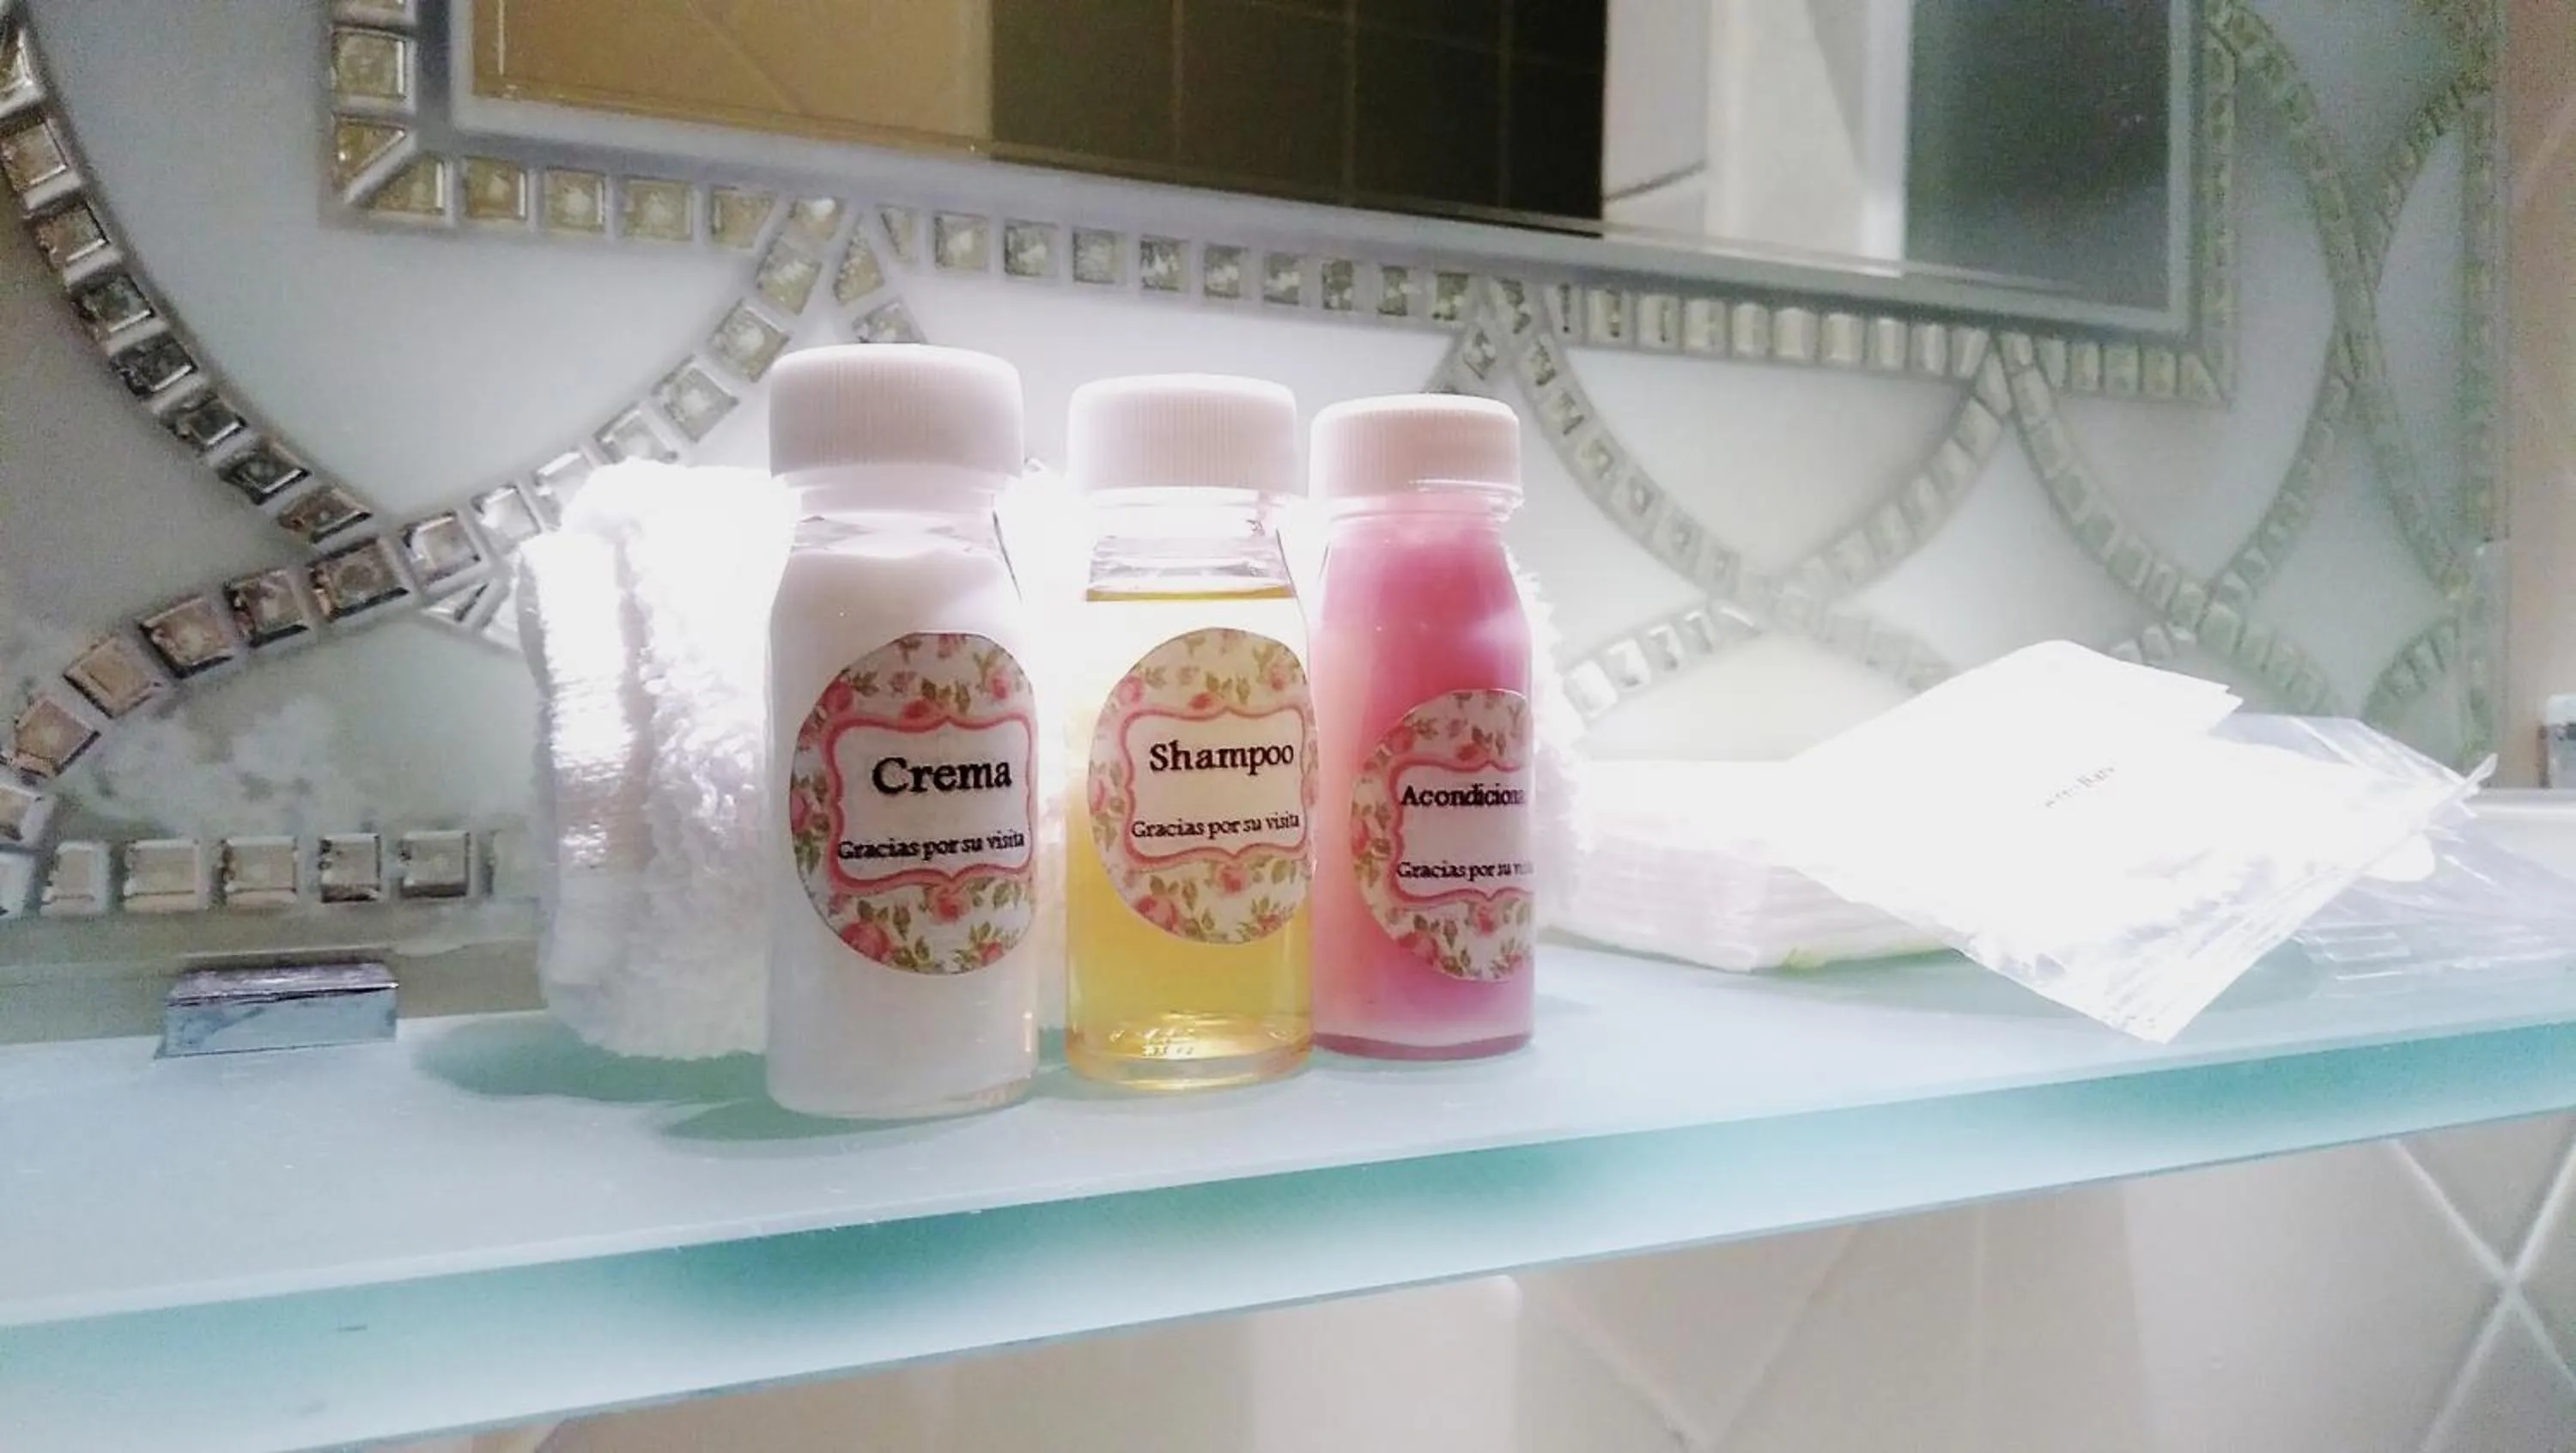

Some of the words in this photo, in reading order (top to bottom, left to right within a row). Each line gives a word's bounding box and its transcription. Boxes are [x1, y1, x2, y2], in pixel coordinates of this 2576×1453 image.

[1148, 739, 1295, 776] Shampoo
[872, 756, 1013, 795] Crema
[1131, 818, 1205, 838] Gracias
[1207, 820, 1242, 840] por
[1242, 817, 1261, 833] su
[1266, 811, 1300, 830] visita
[836, 837, 920, 860] Gracias
[920, 838, 961, 861] por
[961, 836, 984, 854] su
[986, 828, 1026, 851] visita
[1396, 860, 1467, 879] Gracias
[1468, 864, 1496, 882] por
